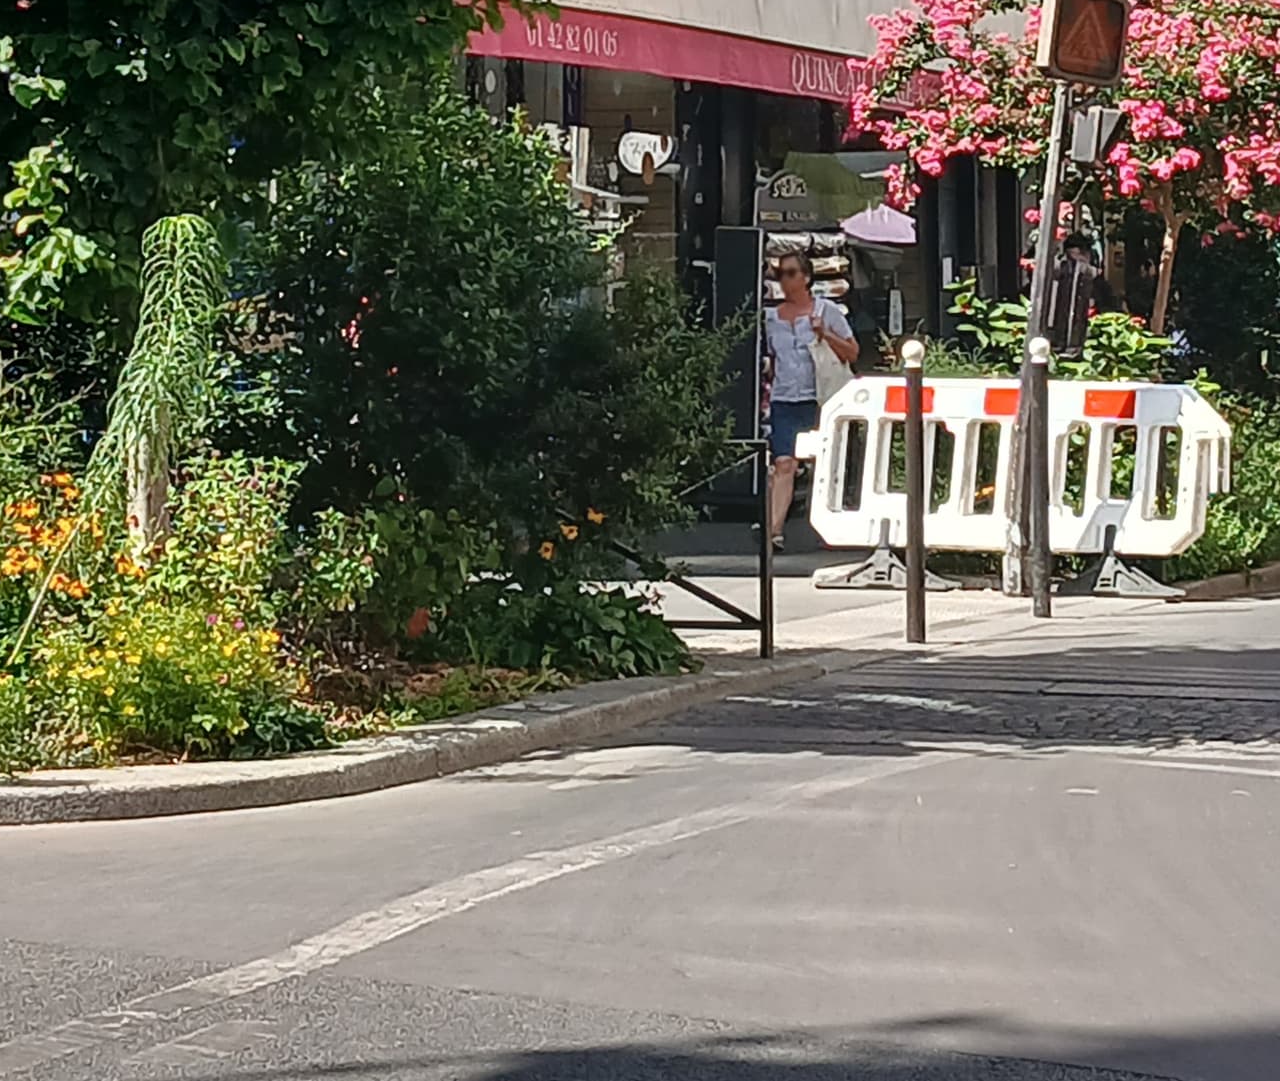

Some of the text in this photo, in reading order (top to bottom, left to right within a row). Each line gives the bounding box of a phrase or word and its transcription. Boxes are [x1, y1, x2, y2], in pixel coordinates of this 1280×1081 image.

[526, 20, 543, 48] 01
[547, 22, 563, 50] 42
[566, 24, 580, 53] 82
[583, 28, 600, 56] 01
